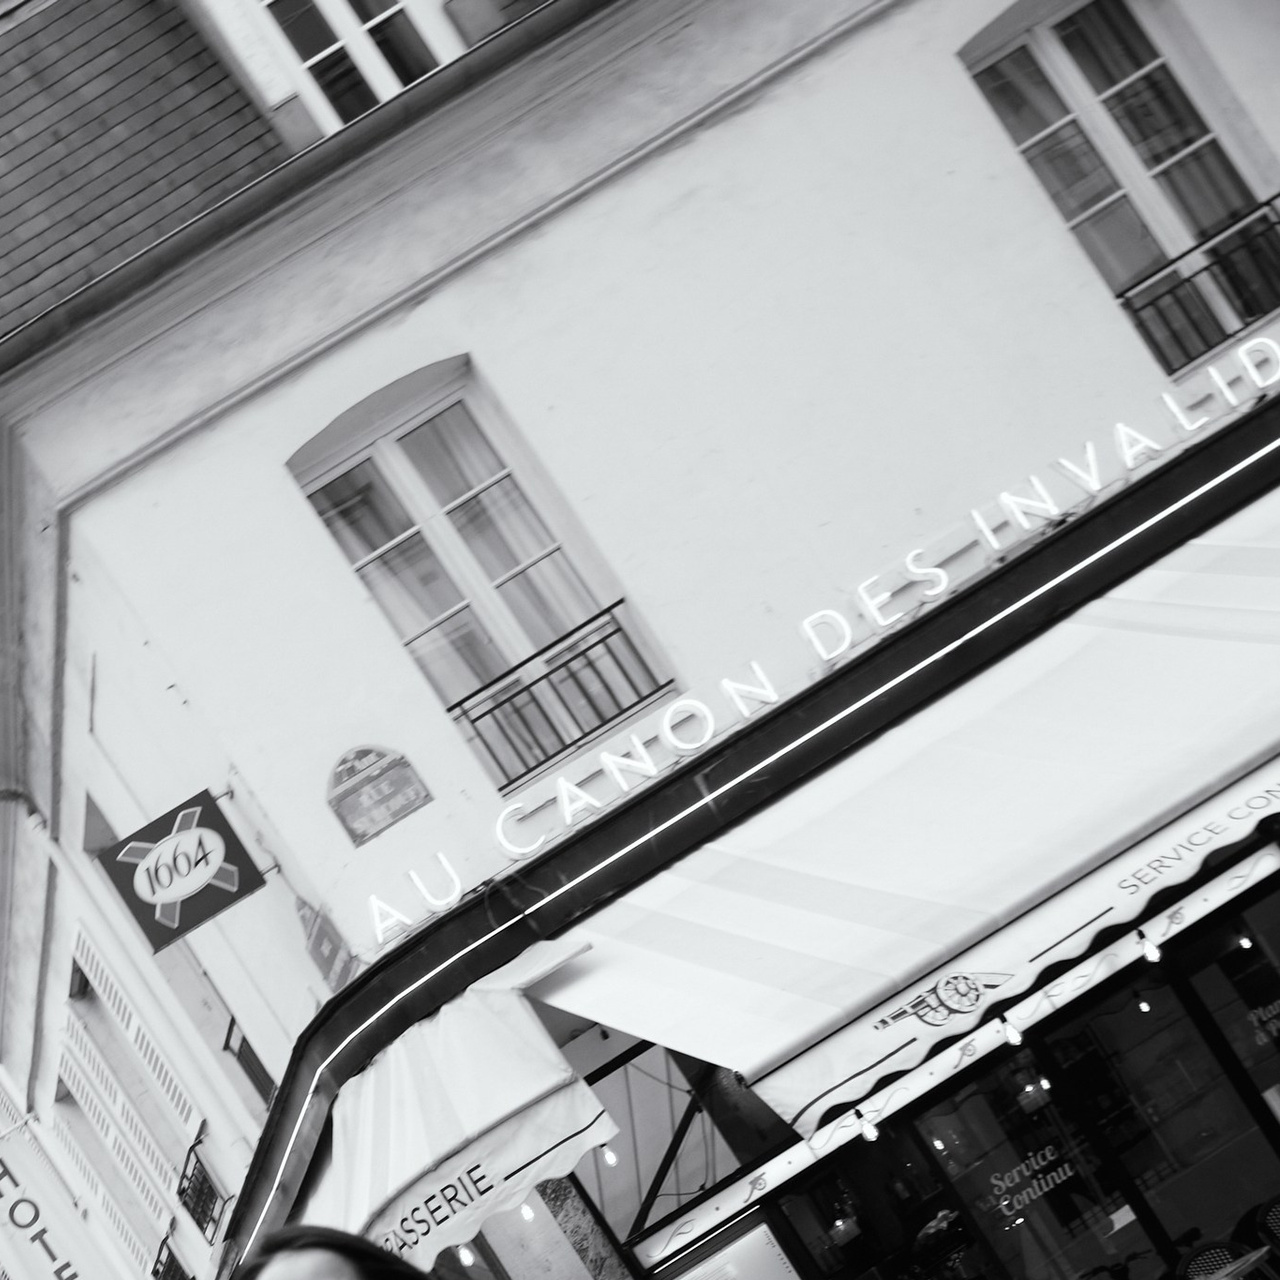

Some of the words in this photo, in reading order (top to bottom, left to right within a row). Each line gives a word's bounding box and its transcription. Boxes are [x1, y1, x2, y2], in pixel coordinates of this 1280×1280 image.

[366, 851, 461, 944] AU
[494, 658, 779, 859] CANON
[800, 547, 949, 662] DES
[970, 337, 1280, 551] INVALID
[144, 835, 215, 898] 1664
[1119, 821, 1228, 895] SERVICE
[990, 1145, 1059, 1195] Service
[999, 1163, 1074, 1216] Continu
